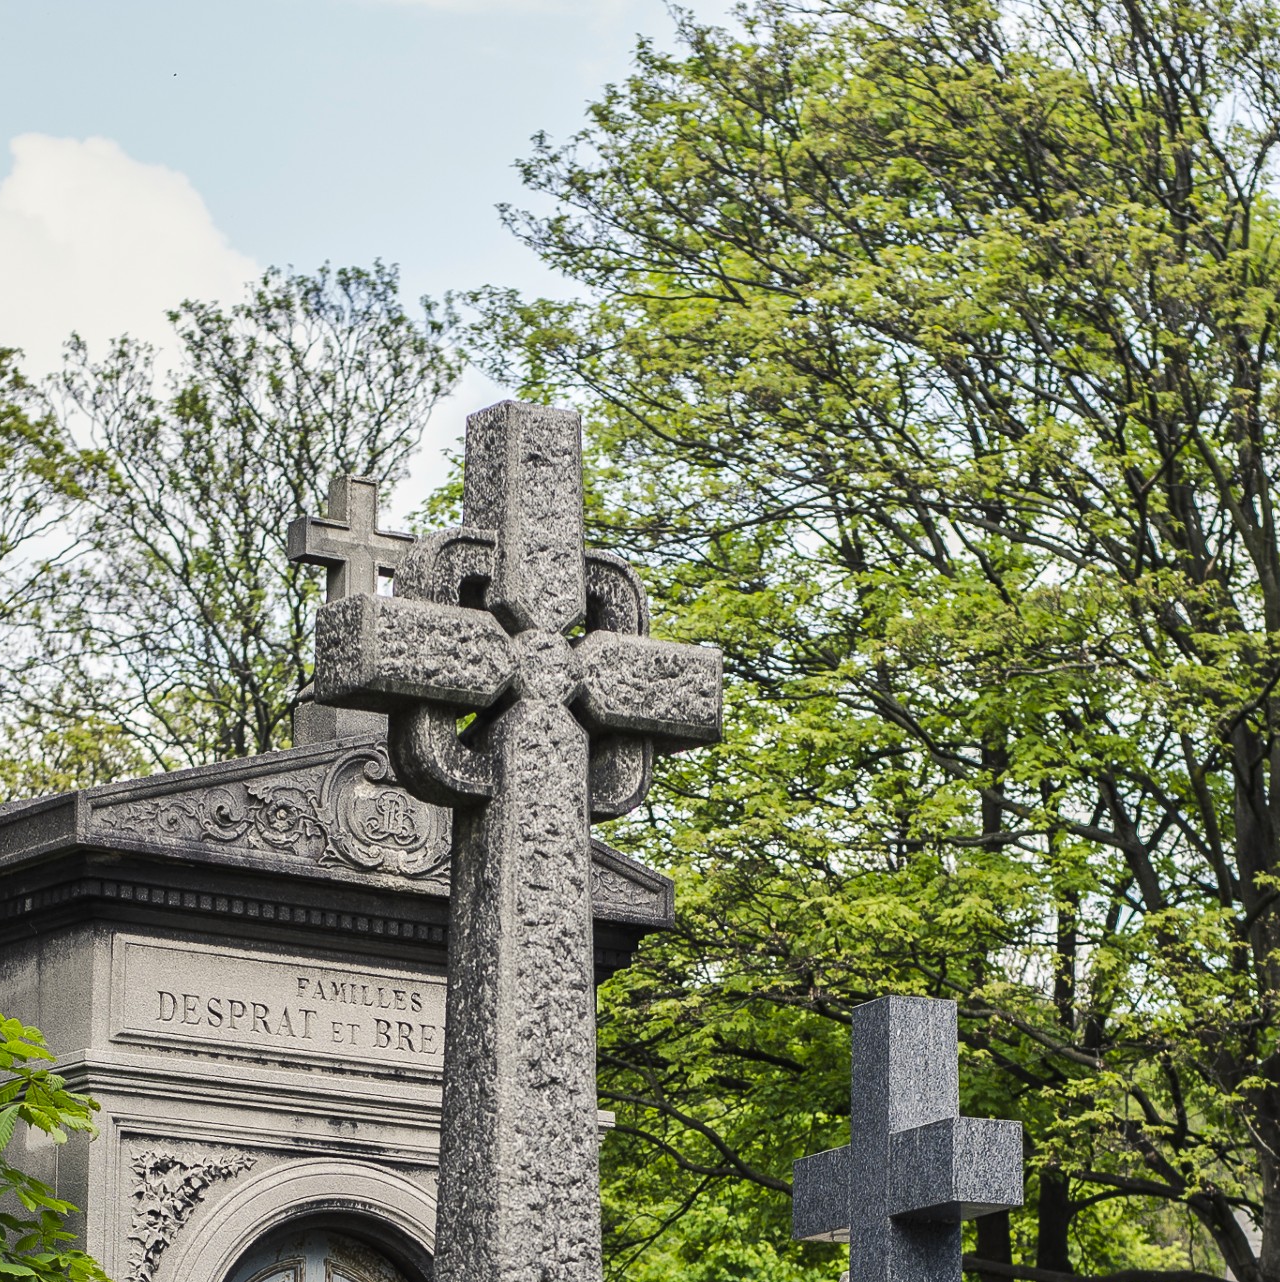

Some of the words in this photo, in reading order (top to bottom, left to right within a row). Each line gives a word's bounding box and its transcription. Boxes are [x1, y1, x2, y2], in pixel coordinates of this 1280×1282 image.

[297, 977, 423, 1013] FAMILLES
[156, 990, 317, 1039] DESPRAT
[331, 1020, 360, 1046] ET
[372, 1018, 446, 1056] BRE
